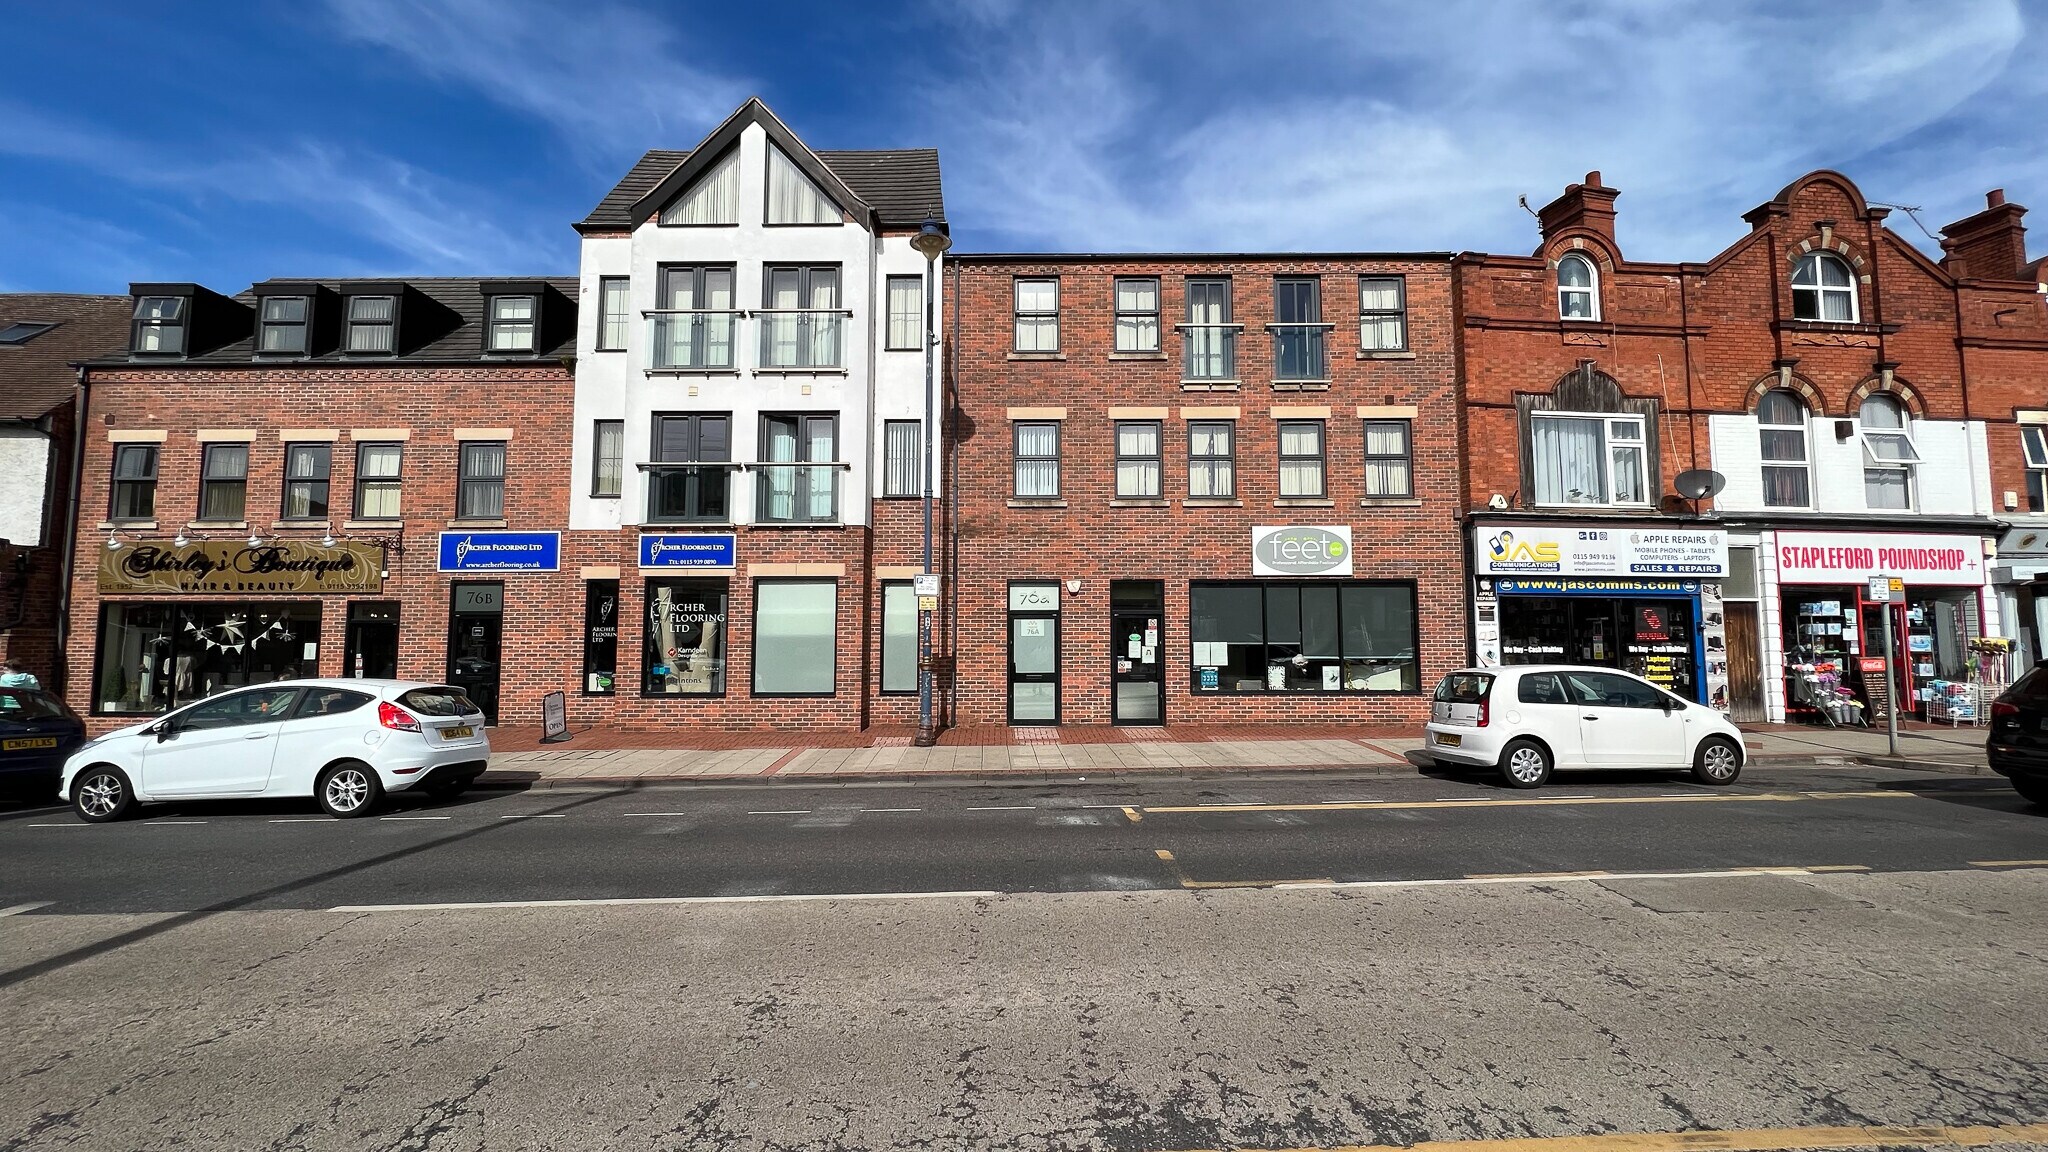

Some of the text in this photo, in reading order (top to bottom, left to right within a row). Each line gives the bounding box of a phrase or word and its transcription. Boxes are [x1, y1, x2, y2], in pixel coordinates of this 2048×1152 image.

[1269, 532, 1331, 560] feet
[1643, 535, 1707, 544] APPLE REPAIRS
[122, 546, 355, 581] Shirley's Boutique
[1782, 546, 1874, 569] STAPLEFORD
[1879, 548, 1965, 571] POUNDSHOP
[181, 582, 294, 591] HAIR & BEAUTY
[1516, 579, 1681, 592] www.jascomms.com
[467, 591, 493, 605] 76B
[1020, 591, 1050, 605] 76a
[669, 613, 725, 622] FLOORING
[669, 624, 690, 633] LTD
[548, 722, 563, 731] OPEN
